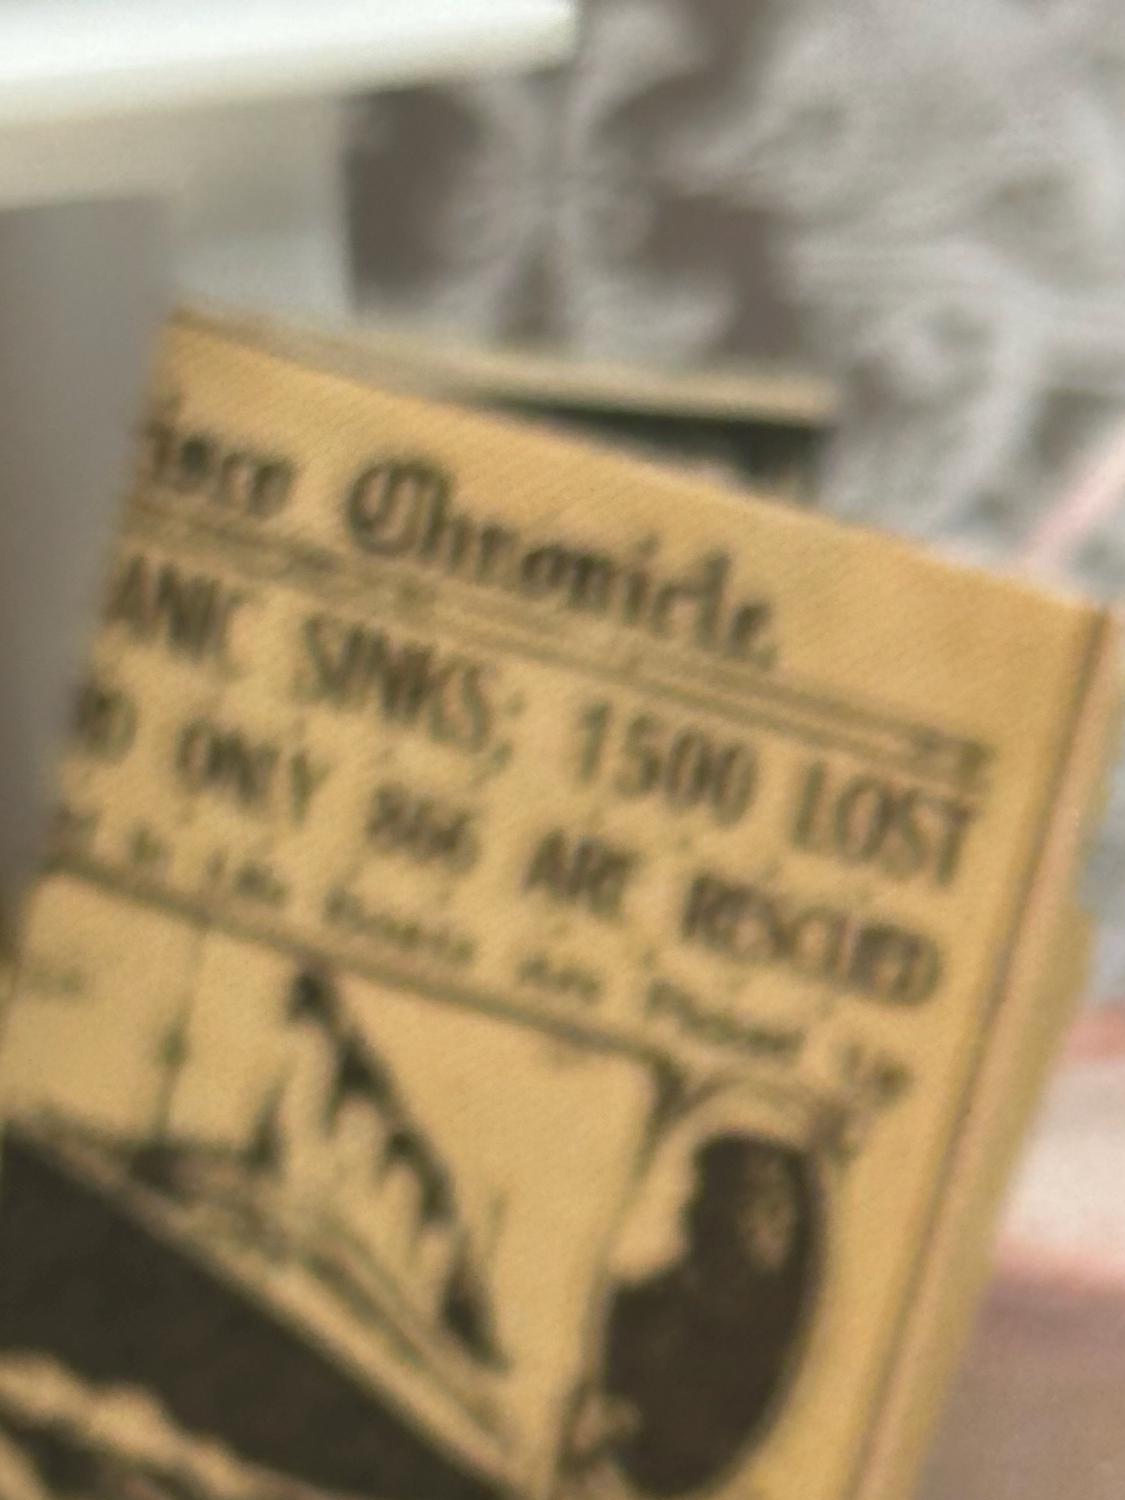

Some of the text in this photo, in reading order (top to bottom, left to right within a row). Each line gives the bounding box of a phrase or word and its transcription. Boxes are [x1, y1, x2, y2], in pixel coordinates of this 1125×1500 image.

[174, 716, 330, 830] ONLY
[680, 870, 946, 1010] RESCUED
[575, 700, 762, 830] 1500
[790, 756, 980, 892] LOST
